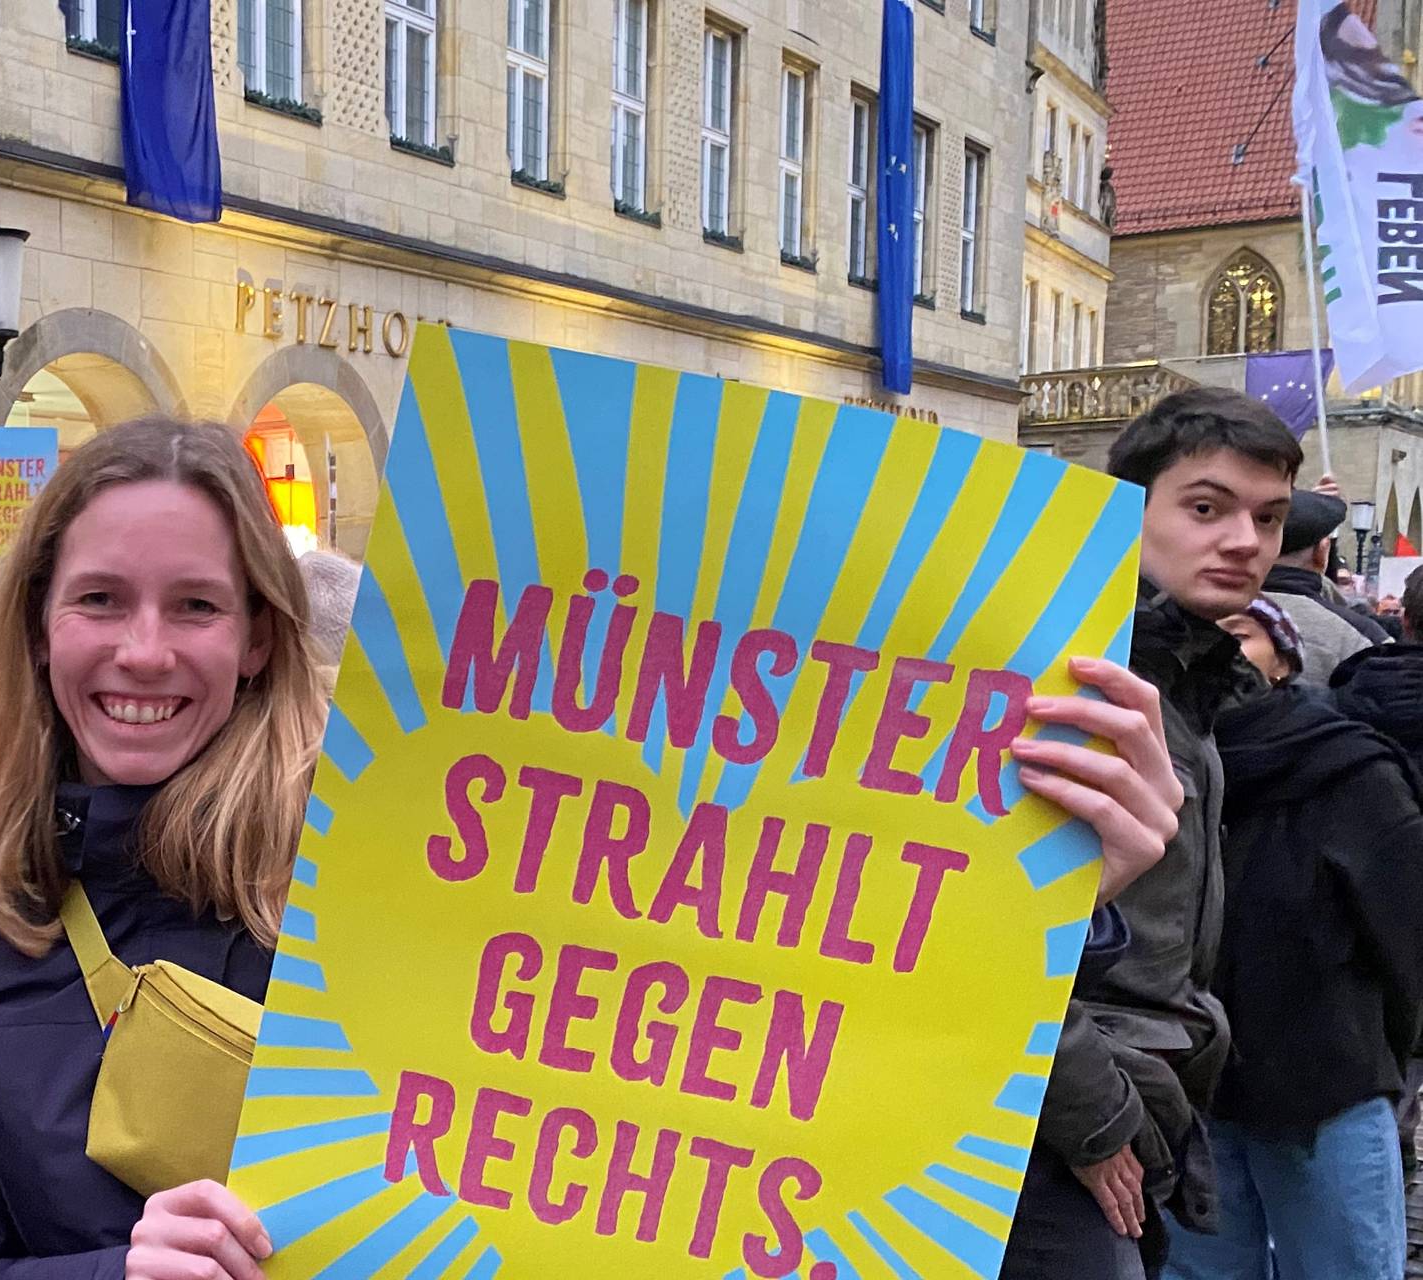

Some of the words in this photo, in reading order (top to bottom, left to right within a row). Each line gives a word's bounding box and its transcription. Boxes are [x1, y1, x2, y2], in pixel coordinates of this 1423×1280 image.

[235, 281, 453, 358] PETZHO
[441, 568, 1034, 817] MÜNSTER
[426, 754, 970, 973] STRAHLT
[470, 932, 845, 1122] GEGEN
[383, 1069, 838, 1280] RECHTS.
